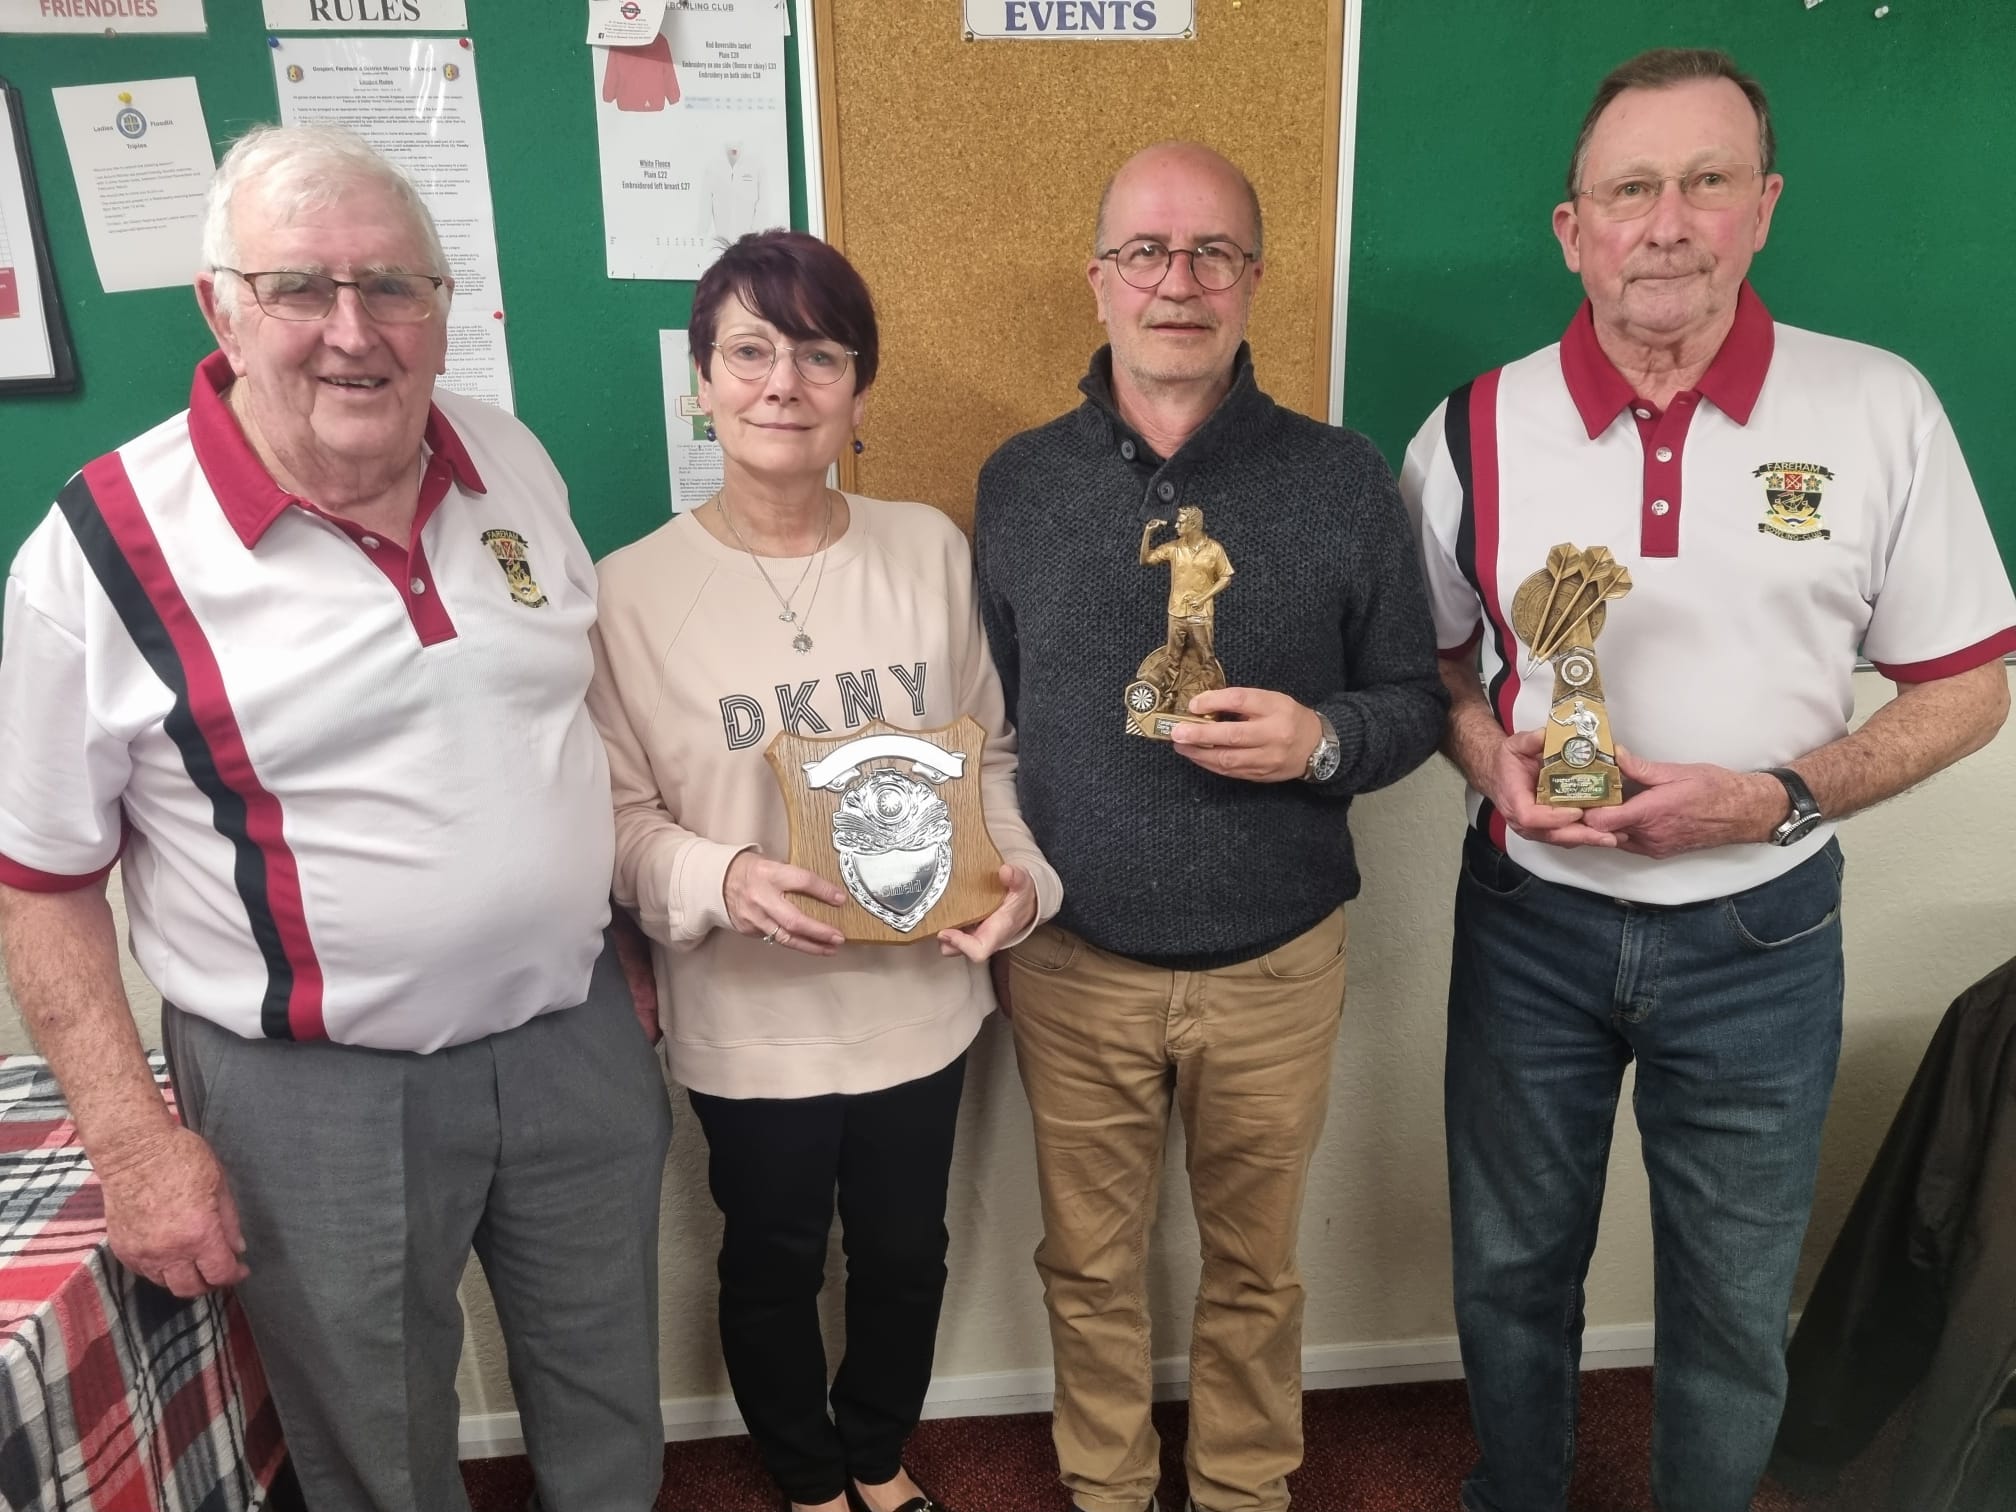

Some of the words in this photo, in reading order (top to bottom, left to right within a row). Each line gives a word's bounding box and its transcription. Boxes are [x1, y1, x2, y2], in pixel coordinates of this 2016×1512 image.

[40, 0, 158, 17] FRIENDLIES
[309, 0, 421, 21] RULES
[711, 3, 734, 12] CLUB
[1005, 0, 1157, 31] EVENTS
[718, 51, 730, 59] Plain
[639, 159, 654, 167] White
[643, 170, 657, 179] Plain
[622, 180, 653, 190] Embroidered
[1767, 462, 1820, 473] FAREHAM
[719, 662, 927, 751] DKNY
